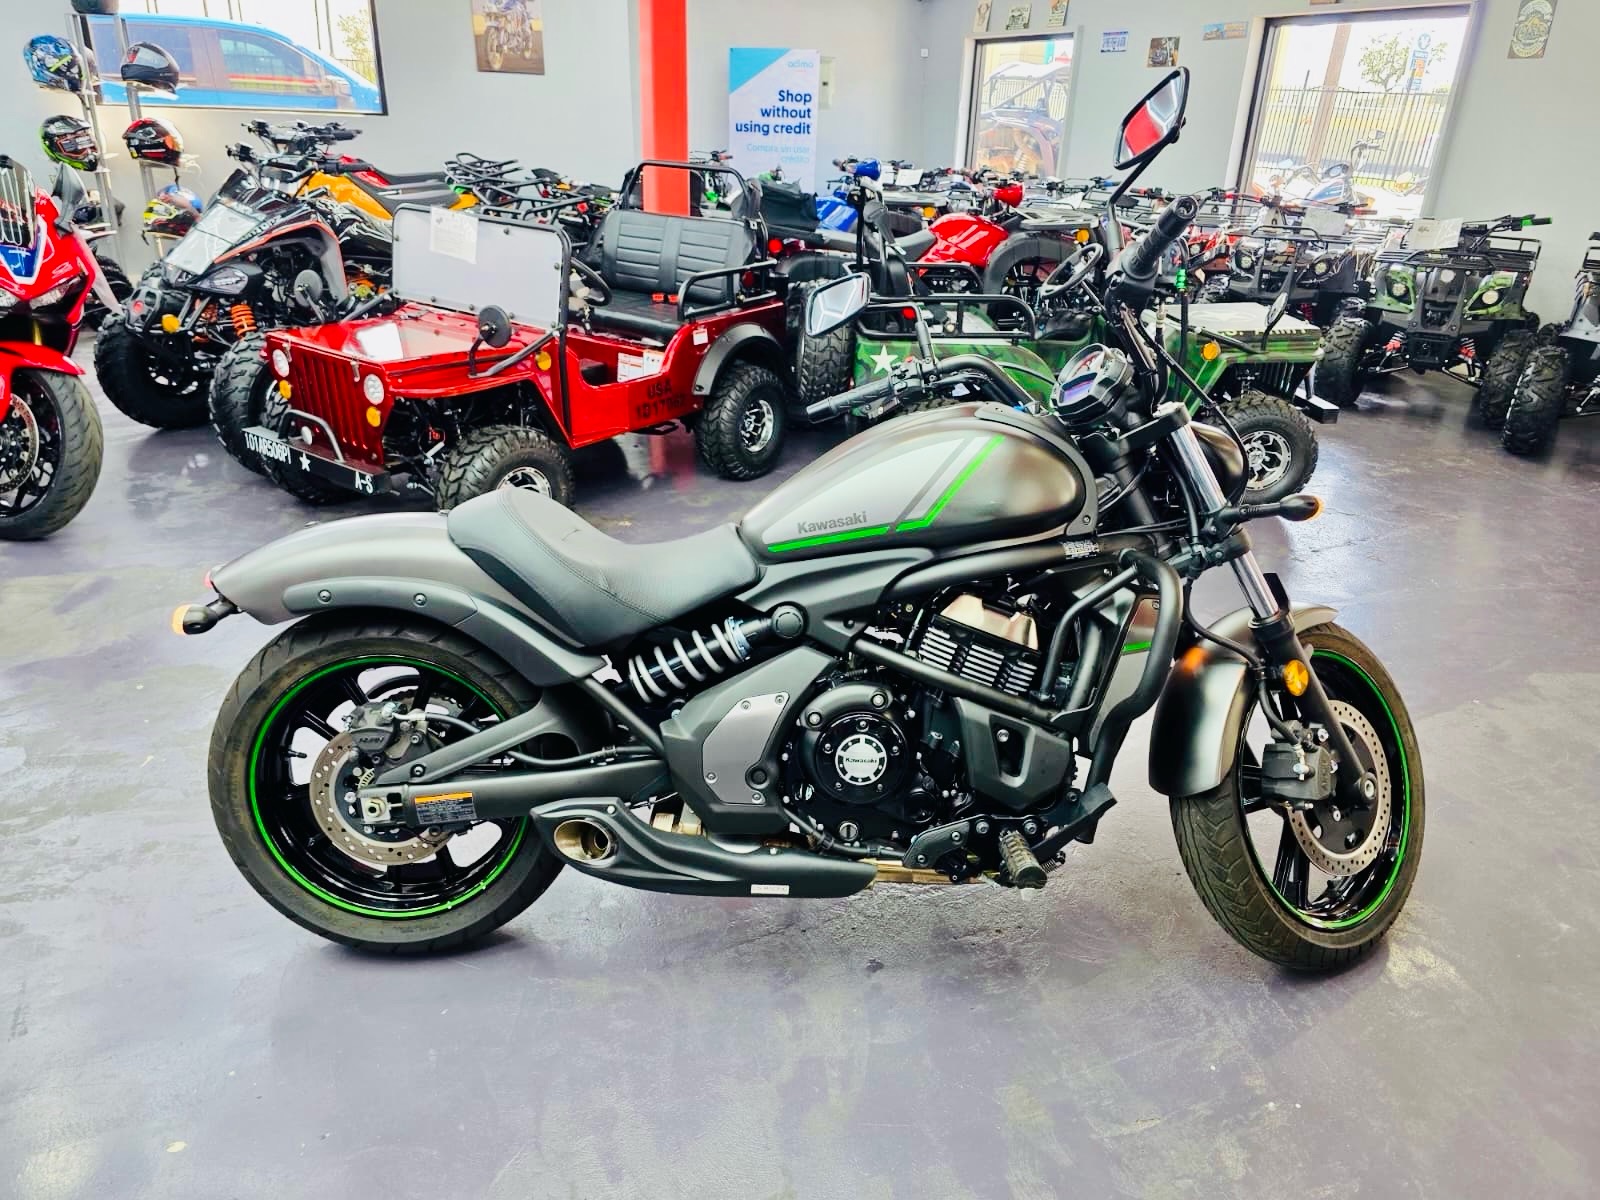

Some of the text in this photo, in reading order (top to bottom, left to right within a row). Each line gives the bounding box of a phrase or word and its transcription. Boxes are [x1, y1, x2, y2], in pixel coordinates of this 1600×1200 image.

[778, 89, 812, 105] Shop
[760, 105, 811, 119] without
[735, 120, 811, 136] using credit
[647, 378, 673, 400] USA
[797, 511, 867, 534] Kawasaki
